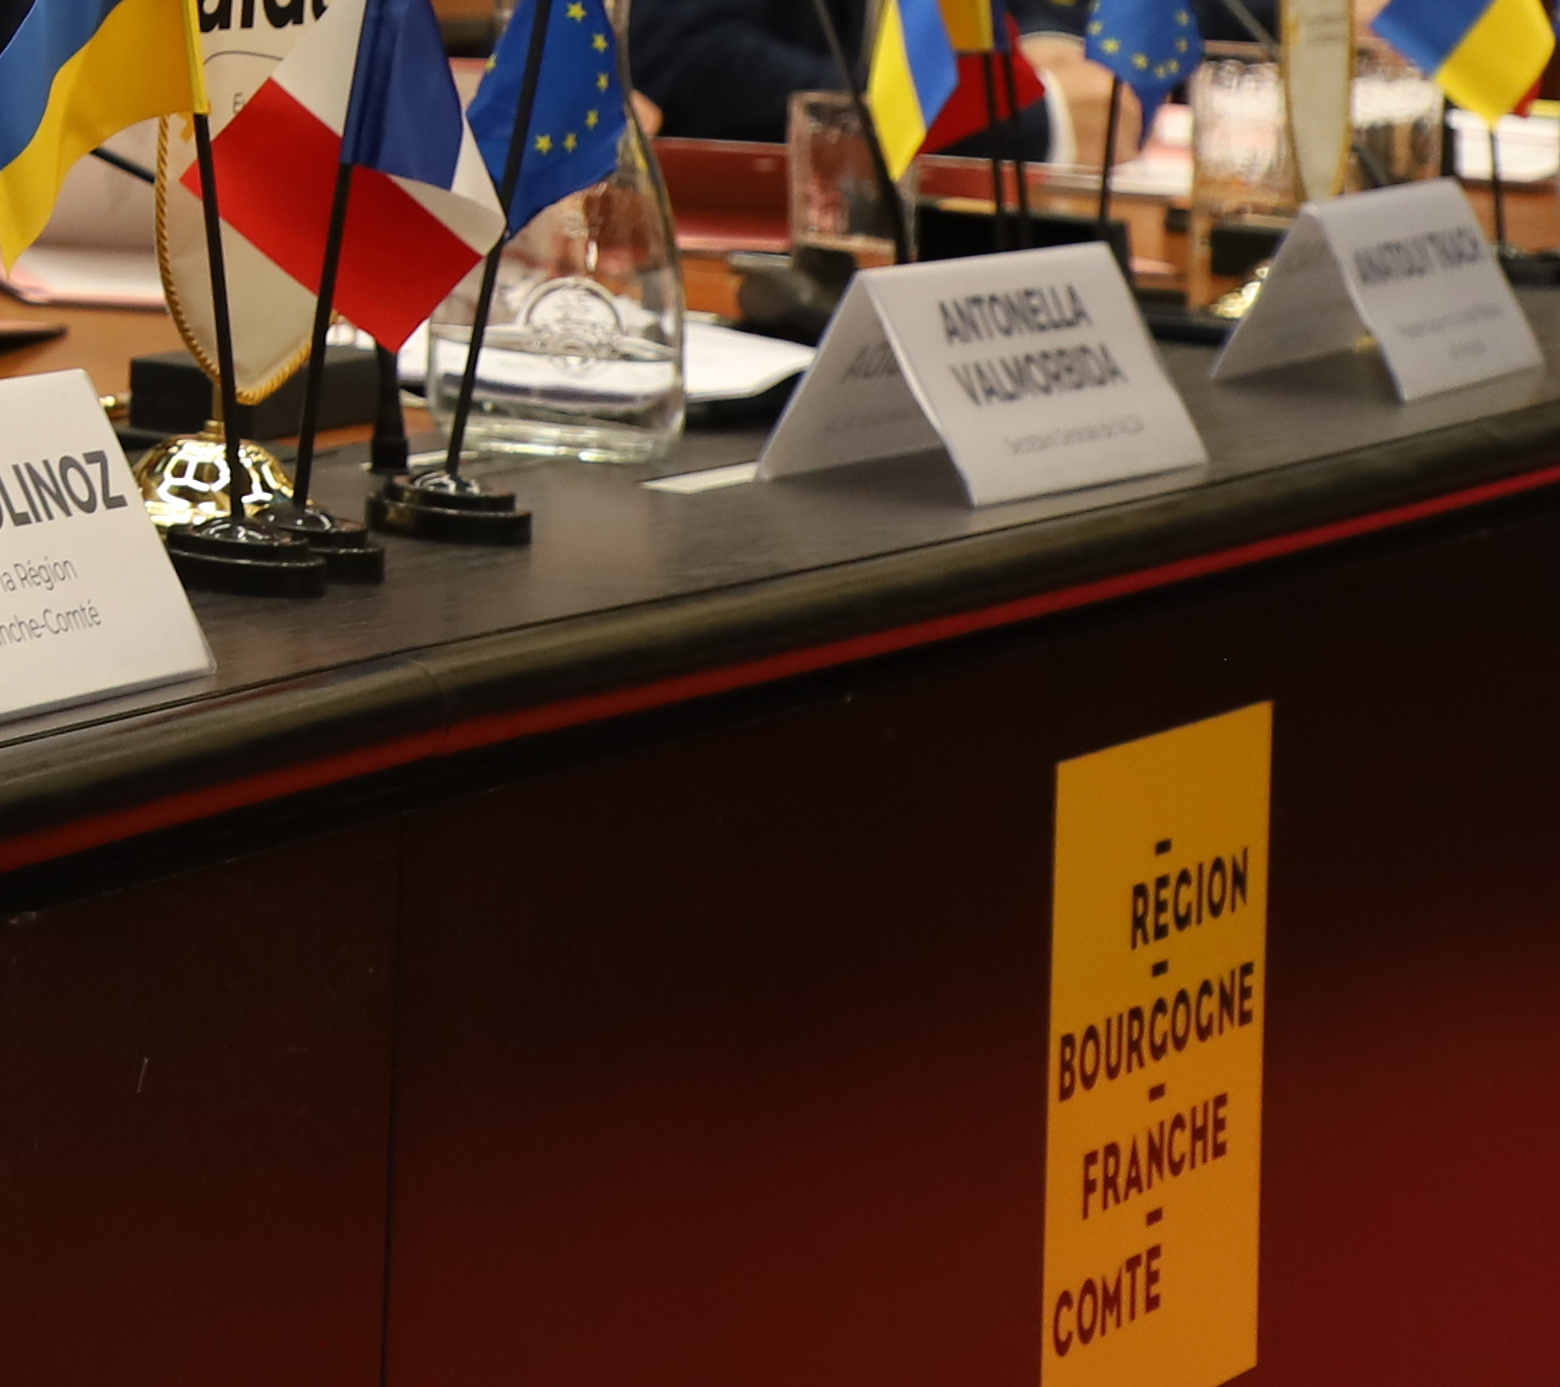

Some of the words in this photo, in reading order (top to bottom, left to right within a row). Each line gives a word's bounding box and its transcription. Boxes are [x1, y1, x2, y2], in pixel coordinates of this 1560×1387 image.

[938, 281, 1094, 345] ANTONELLA
[949, 340, 1130, 407] VALMORBIDA
[0, 563, 17, 593] la
[17, 553, 80, 591] Région
[1058, 960, 1255, 1103] BOURGOGNE
[1081, 1090, 1229, 1220] FRANCHE
